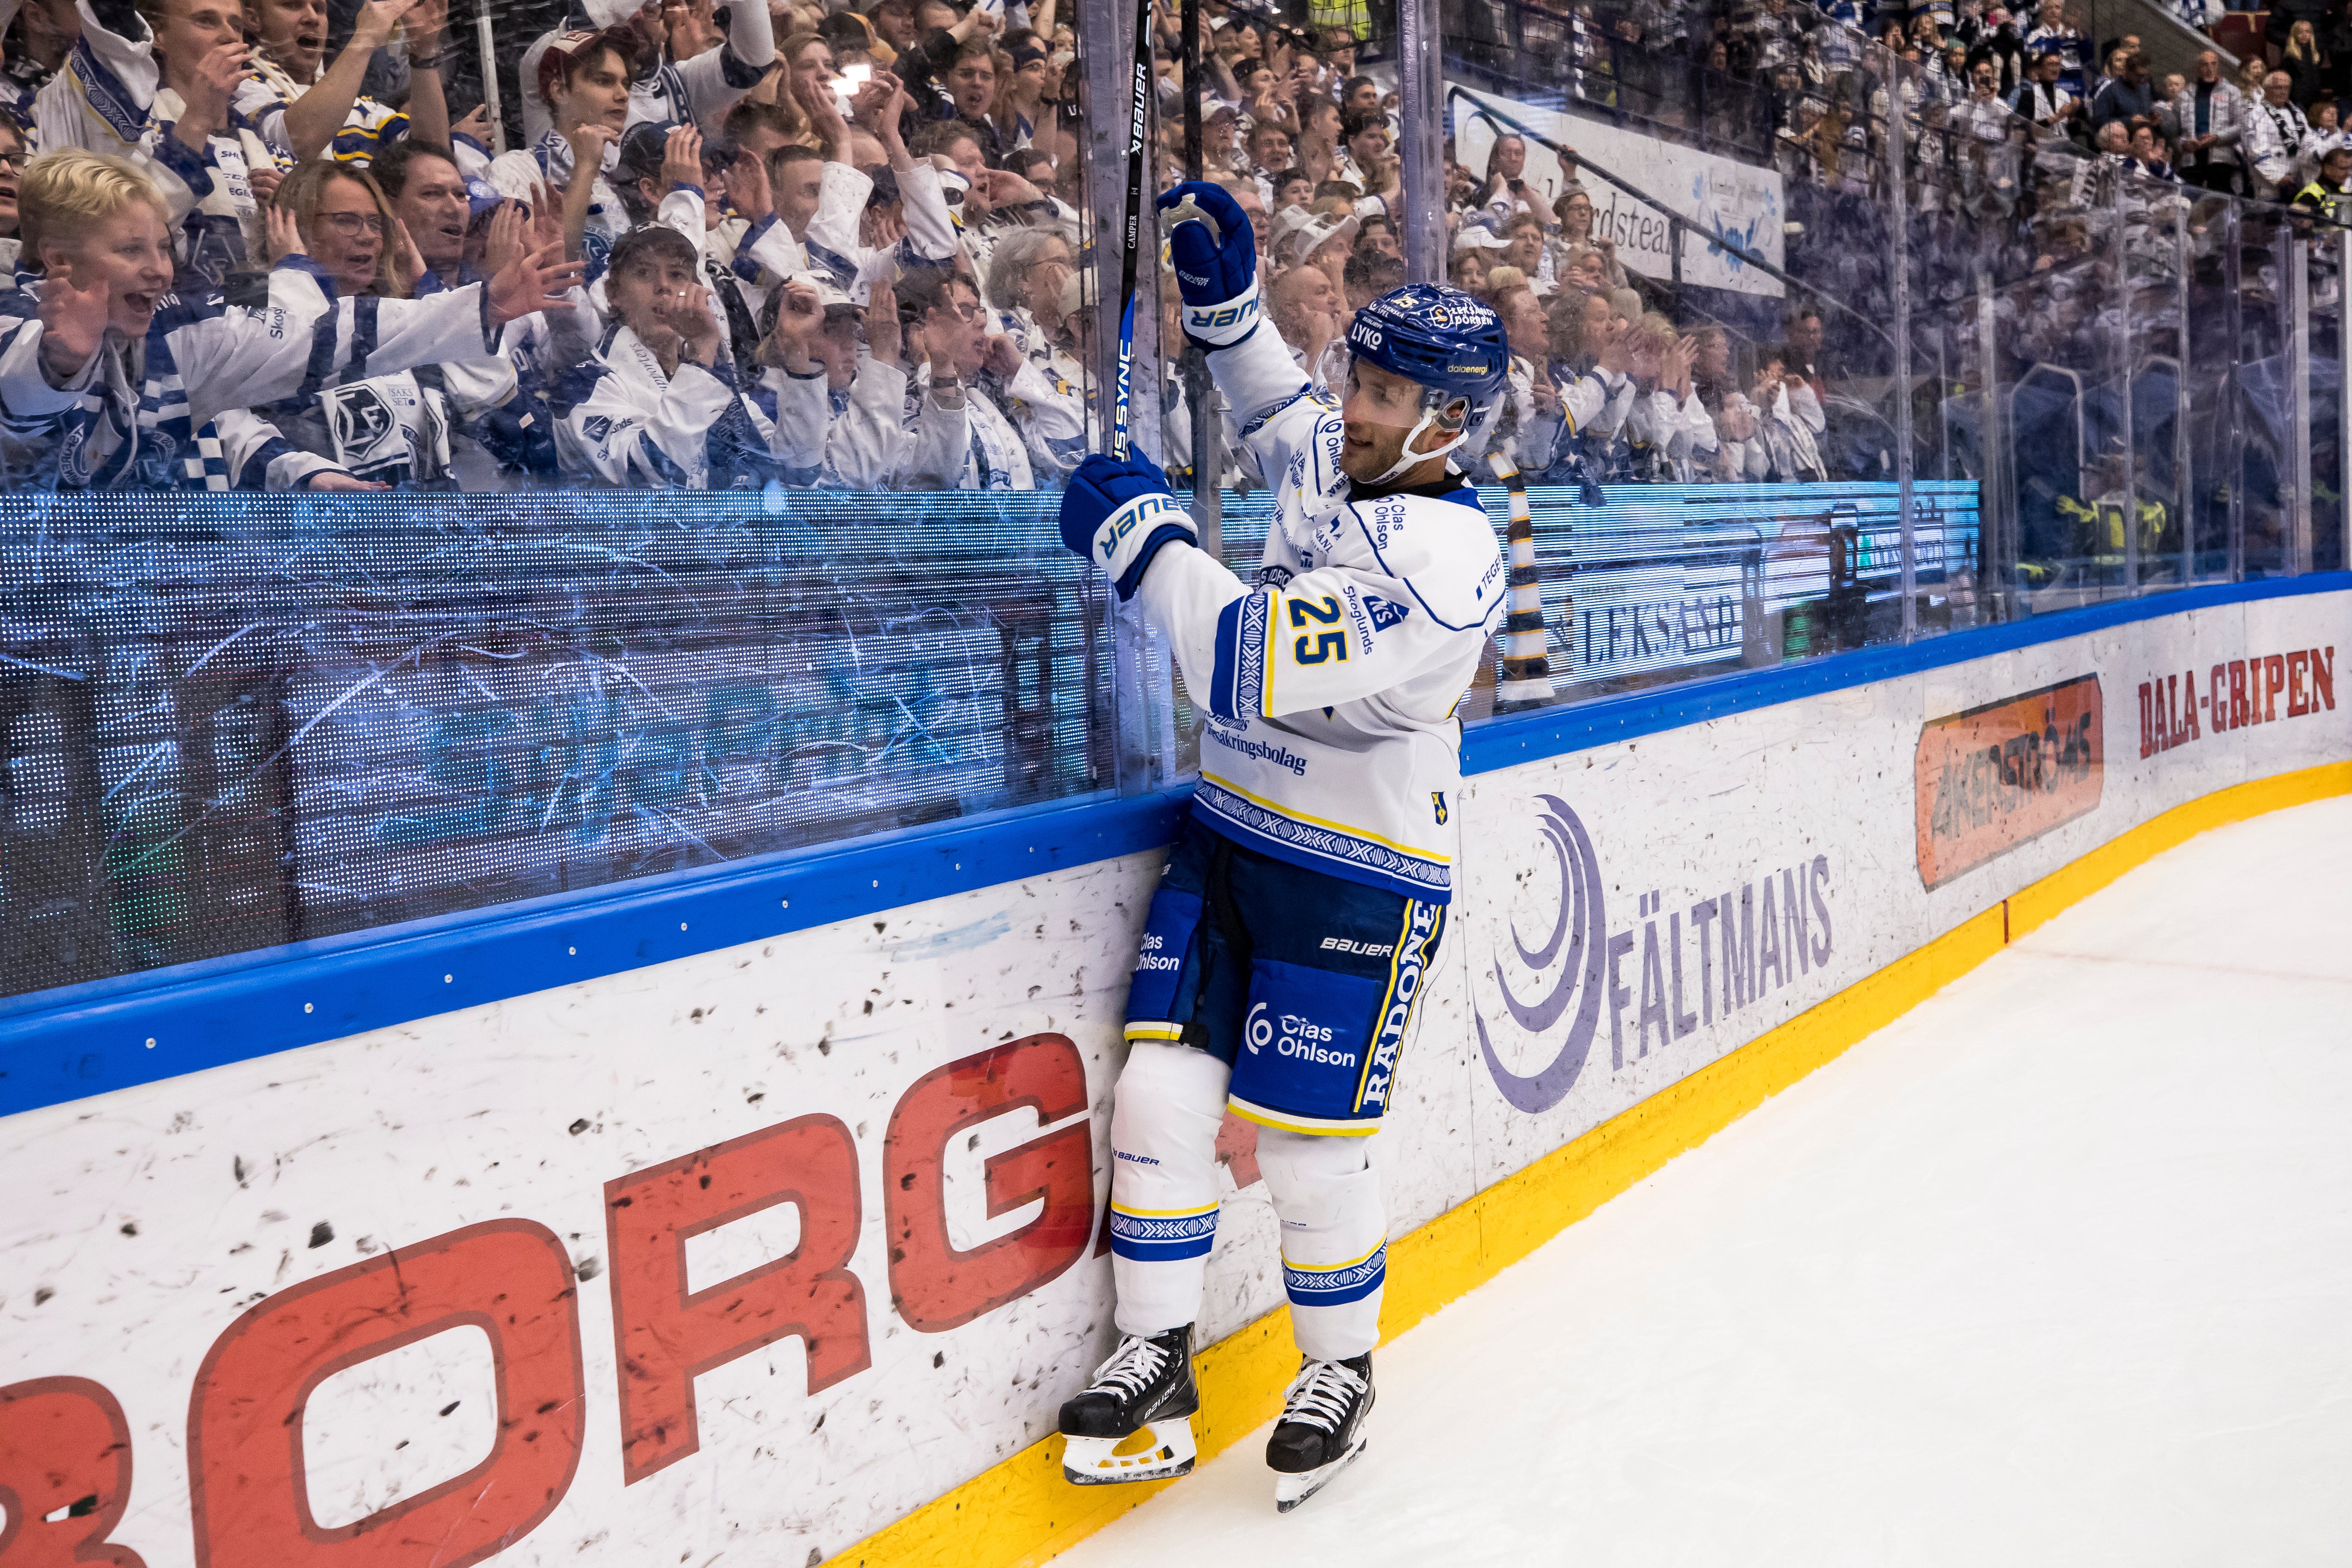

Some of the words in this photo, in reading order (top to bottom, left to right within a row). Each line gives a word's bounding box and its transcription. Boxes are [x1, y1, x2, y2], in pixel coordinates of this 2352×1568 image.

[1132, 62, 1148, 140] BAUER
[1127, 214, 1137, 249] CAMPER
[1377, 308, 1388, 318] SPEL
[1380, 303, 1405, 319] SVENSKA
[1115, 340, 1133, 427] SYNC
[1447, 364, 1488, 376] dalaenergi
[1099, 497, 1182, 560] AUER
[1375, 503, 1388, 550] Ohlson
[1391, 505, 1406, 531] Clas
[1286, 594, 1349, 667] 25
[1343, 585, 1372, 655] Skoglunds
[2139, 646, 2336, 760] DALA-GRIPEN
[1319, 937, 1393, 957] BAUER
[1608, 854, 1832, 1072] FÄLTMANS
[1281, 1014, 1333, 1042] Clas
[1277, 1036, 1356, 1068] Ohlson
[1117, 1151, 1160, 1166] BAUER
[1144, 1382, 1177, 1420] BAUER
